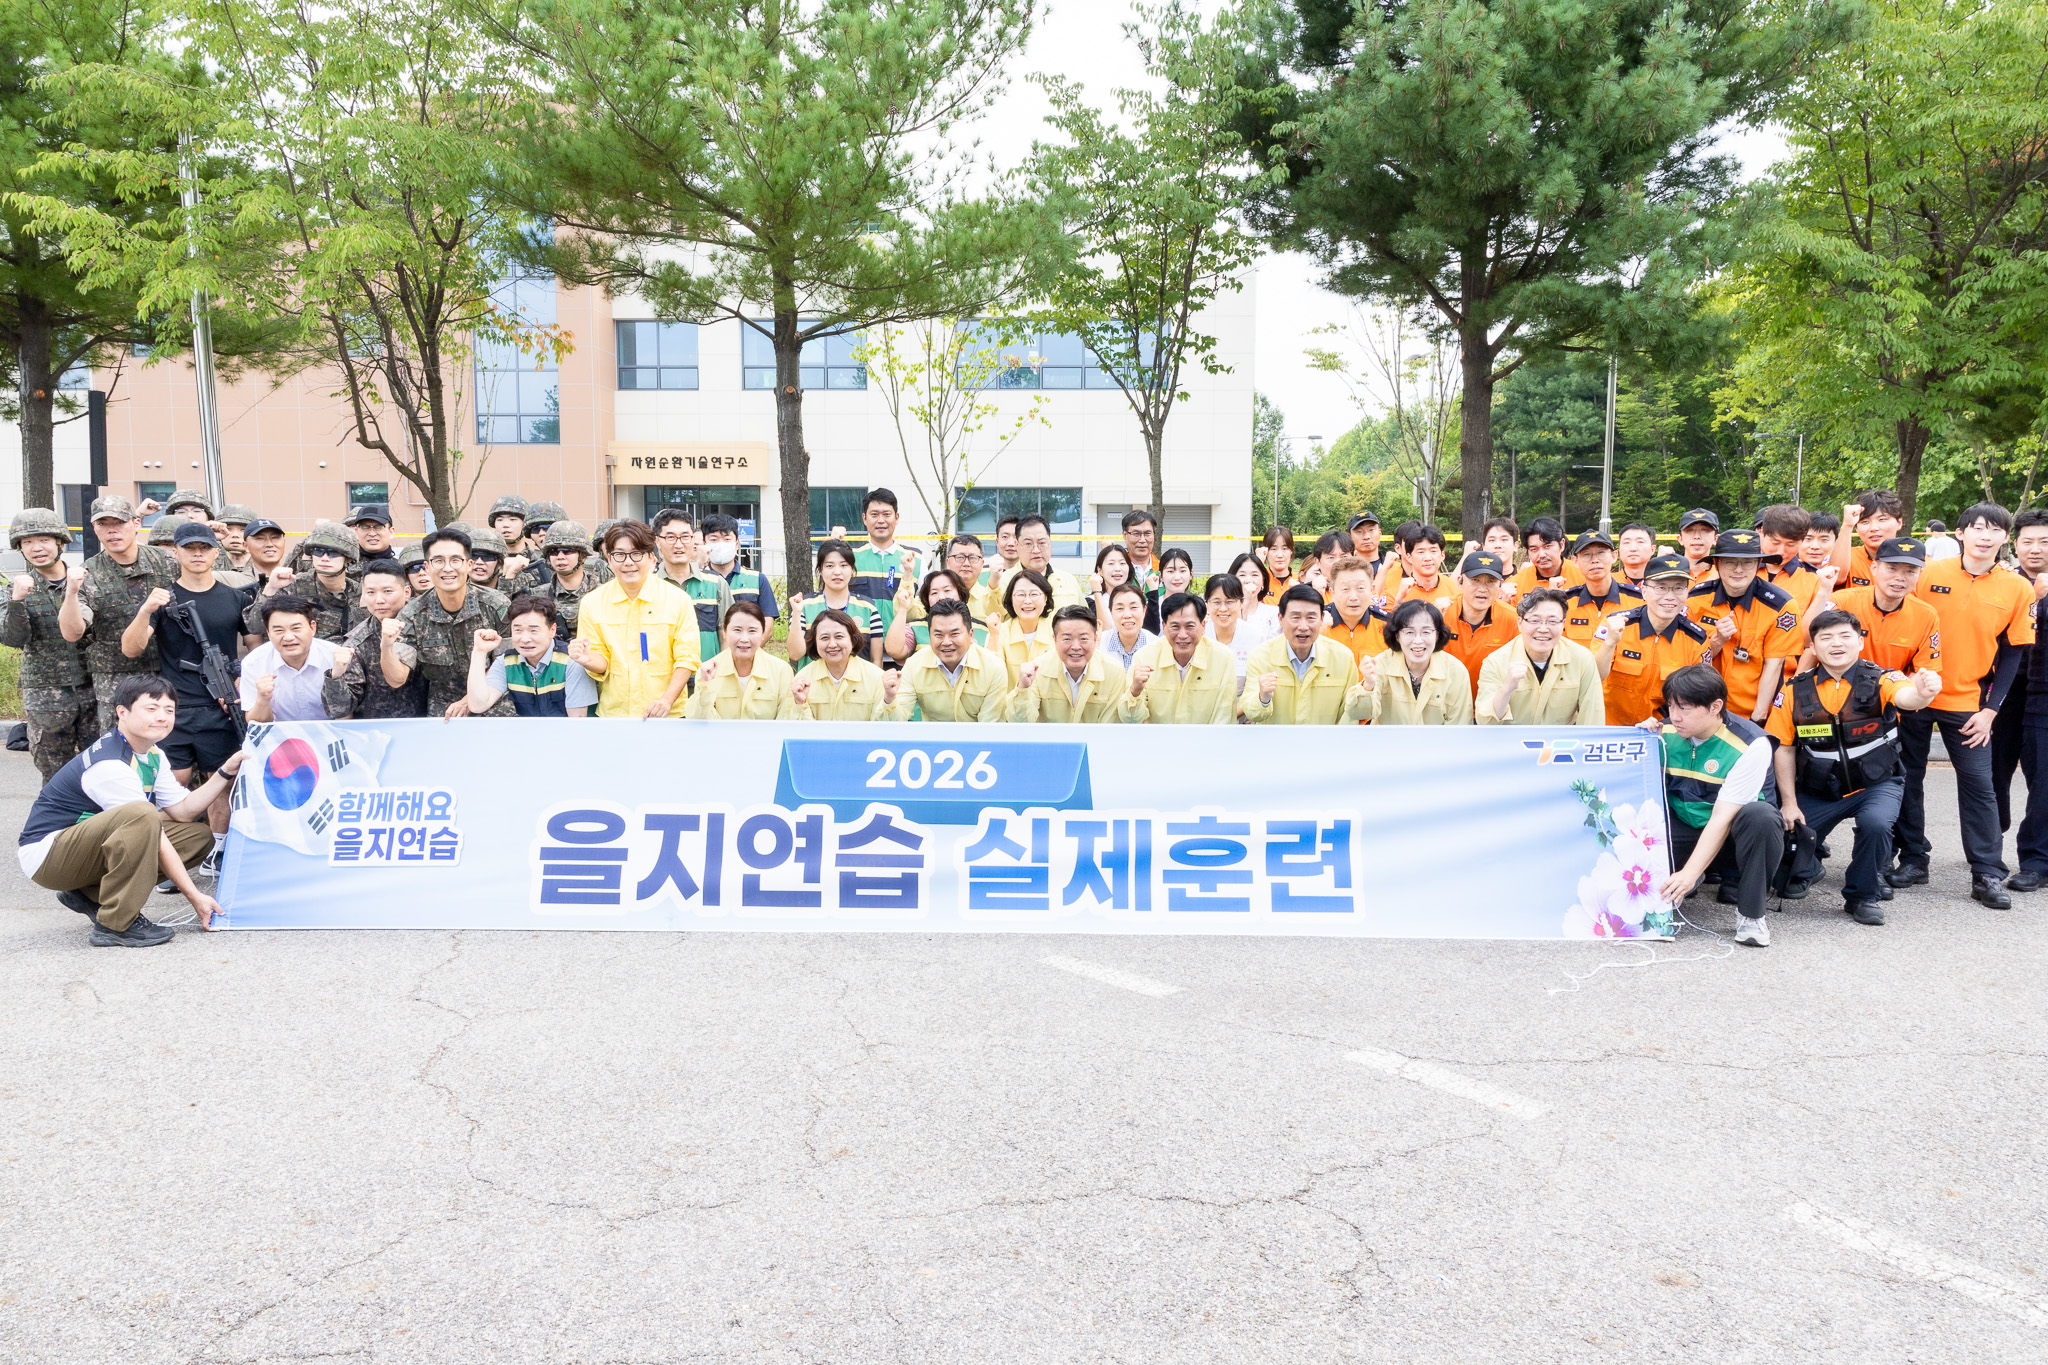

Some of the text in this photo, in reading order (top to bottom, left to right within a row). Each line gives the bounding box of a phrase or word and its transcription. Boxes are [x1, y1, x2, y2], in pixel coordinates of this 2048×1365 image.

[631, 456, 748, 469] 자원순환기술연구소
[1851, 722, 1879, 736] 119
[1584, 742, 1645, 762] 검단구
[865, 749, 998, 790] 2026
[337, 791, 452, 822] 함께해요
[333, 826, 459, 861] 을지연습
[539, 809, 1355, 913] 을지연습 실제훈련
